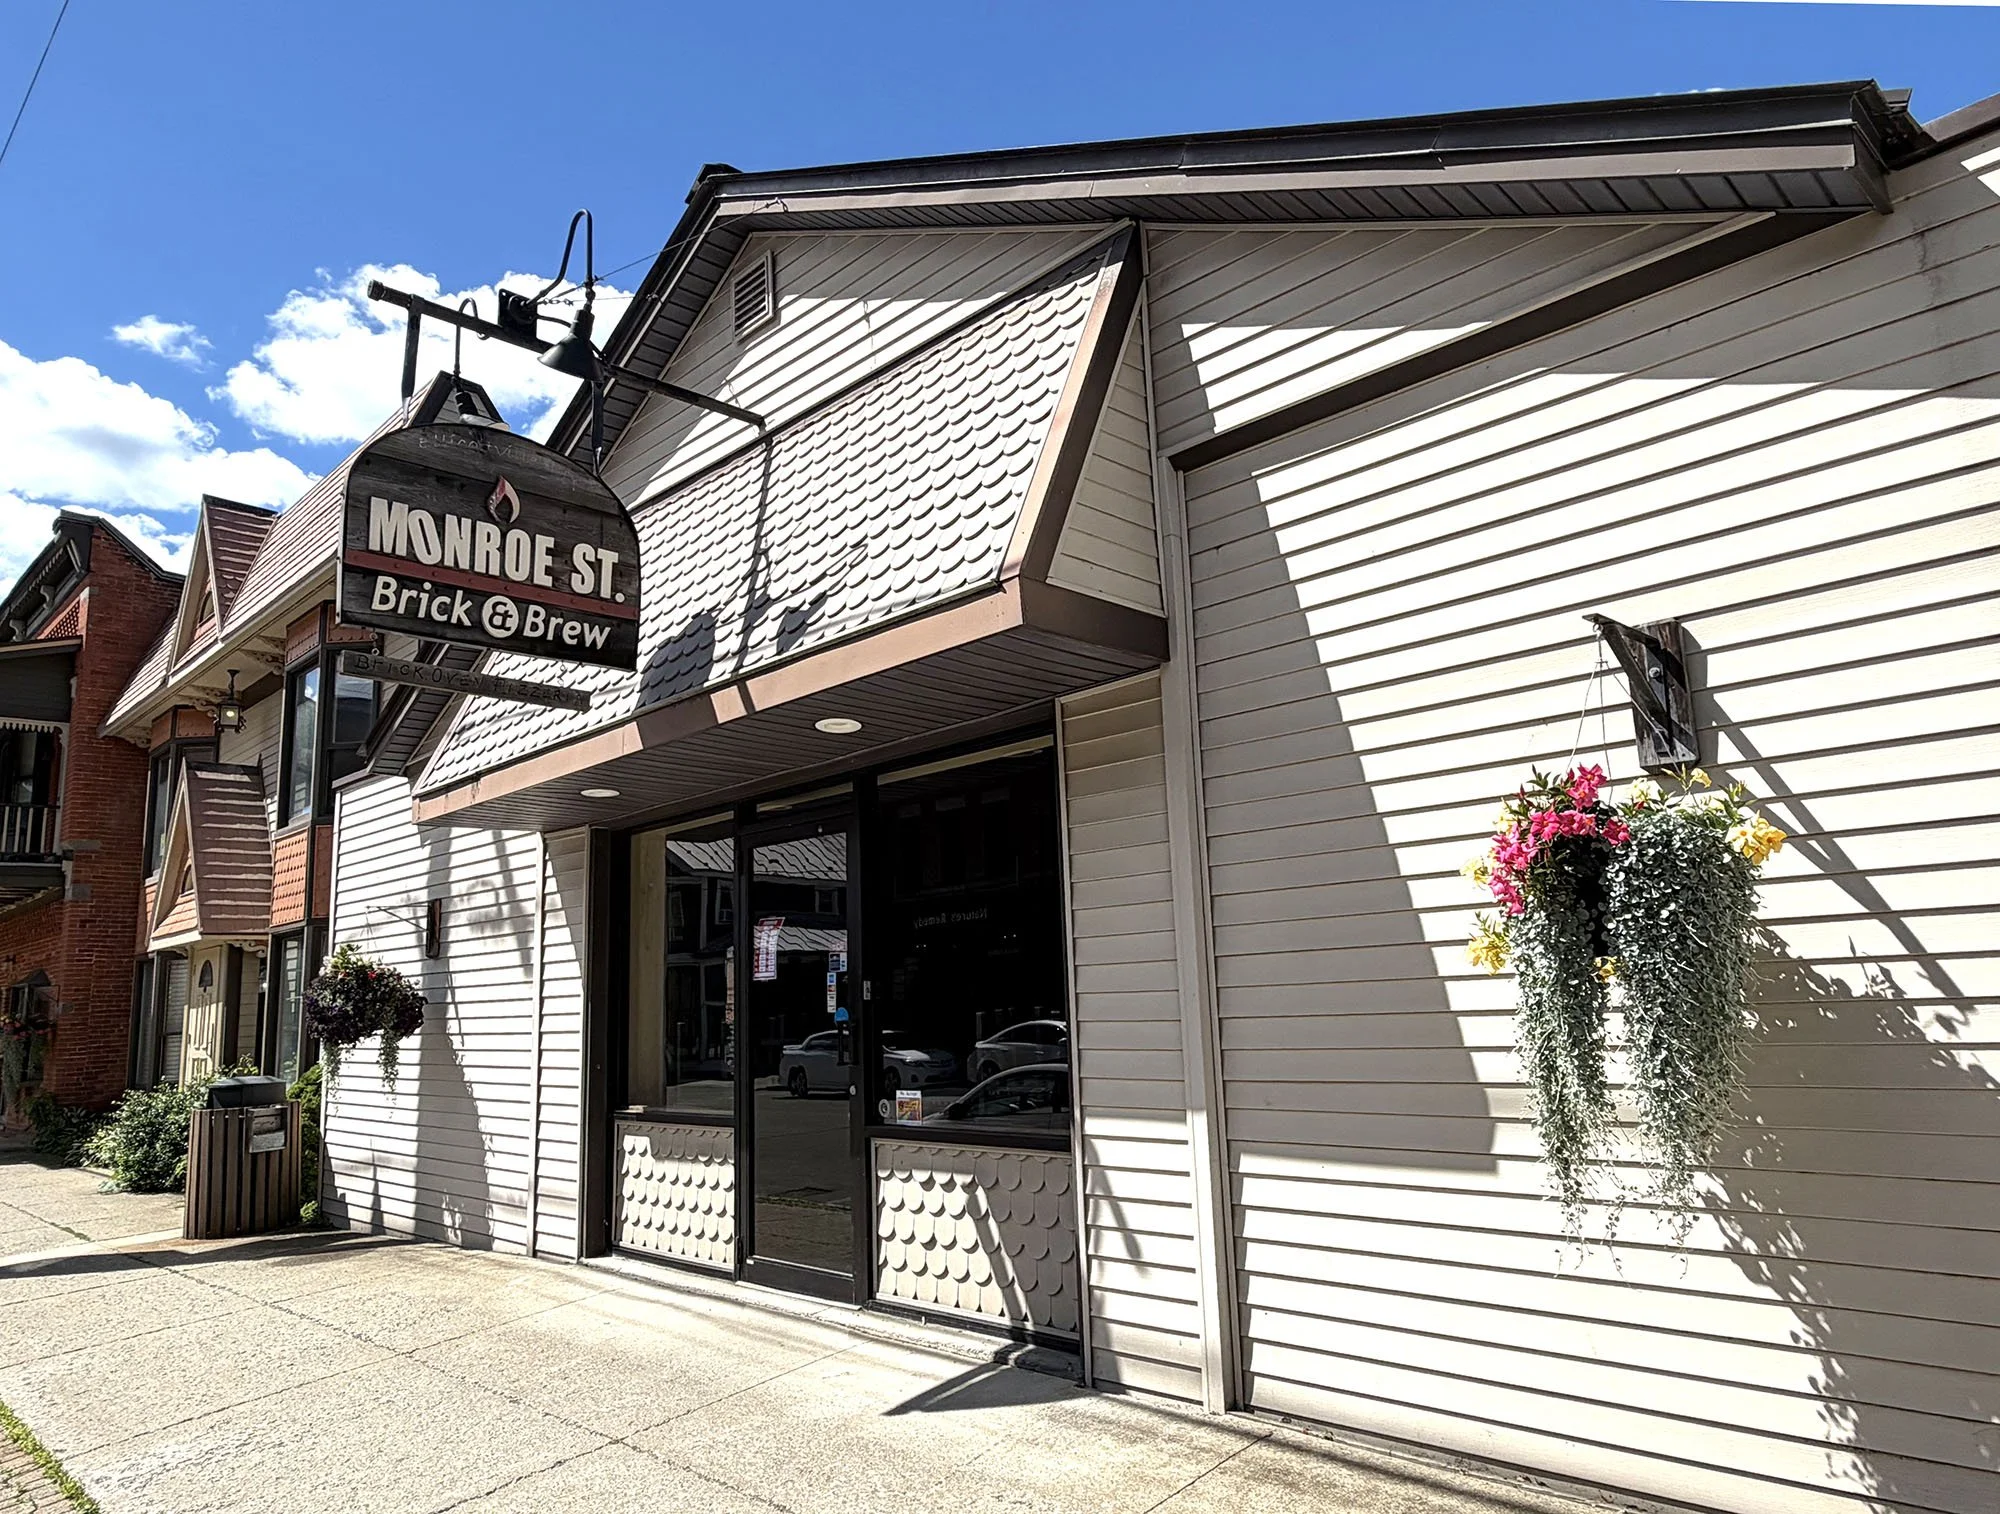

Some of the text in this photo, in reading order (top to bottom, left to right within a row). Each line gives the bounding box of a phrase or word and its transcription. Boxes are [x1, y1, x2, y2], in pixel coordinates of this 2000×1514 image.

[368, 496, 626, 603] MONROE ST.
[371, 575, 611, 650] Brick & Brew
